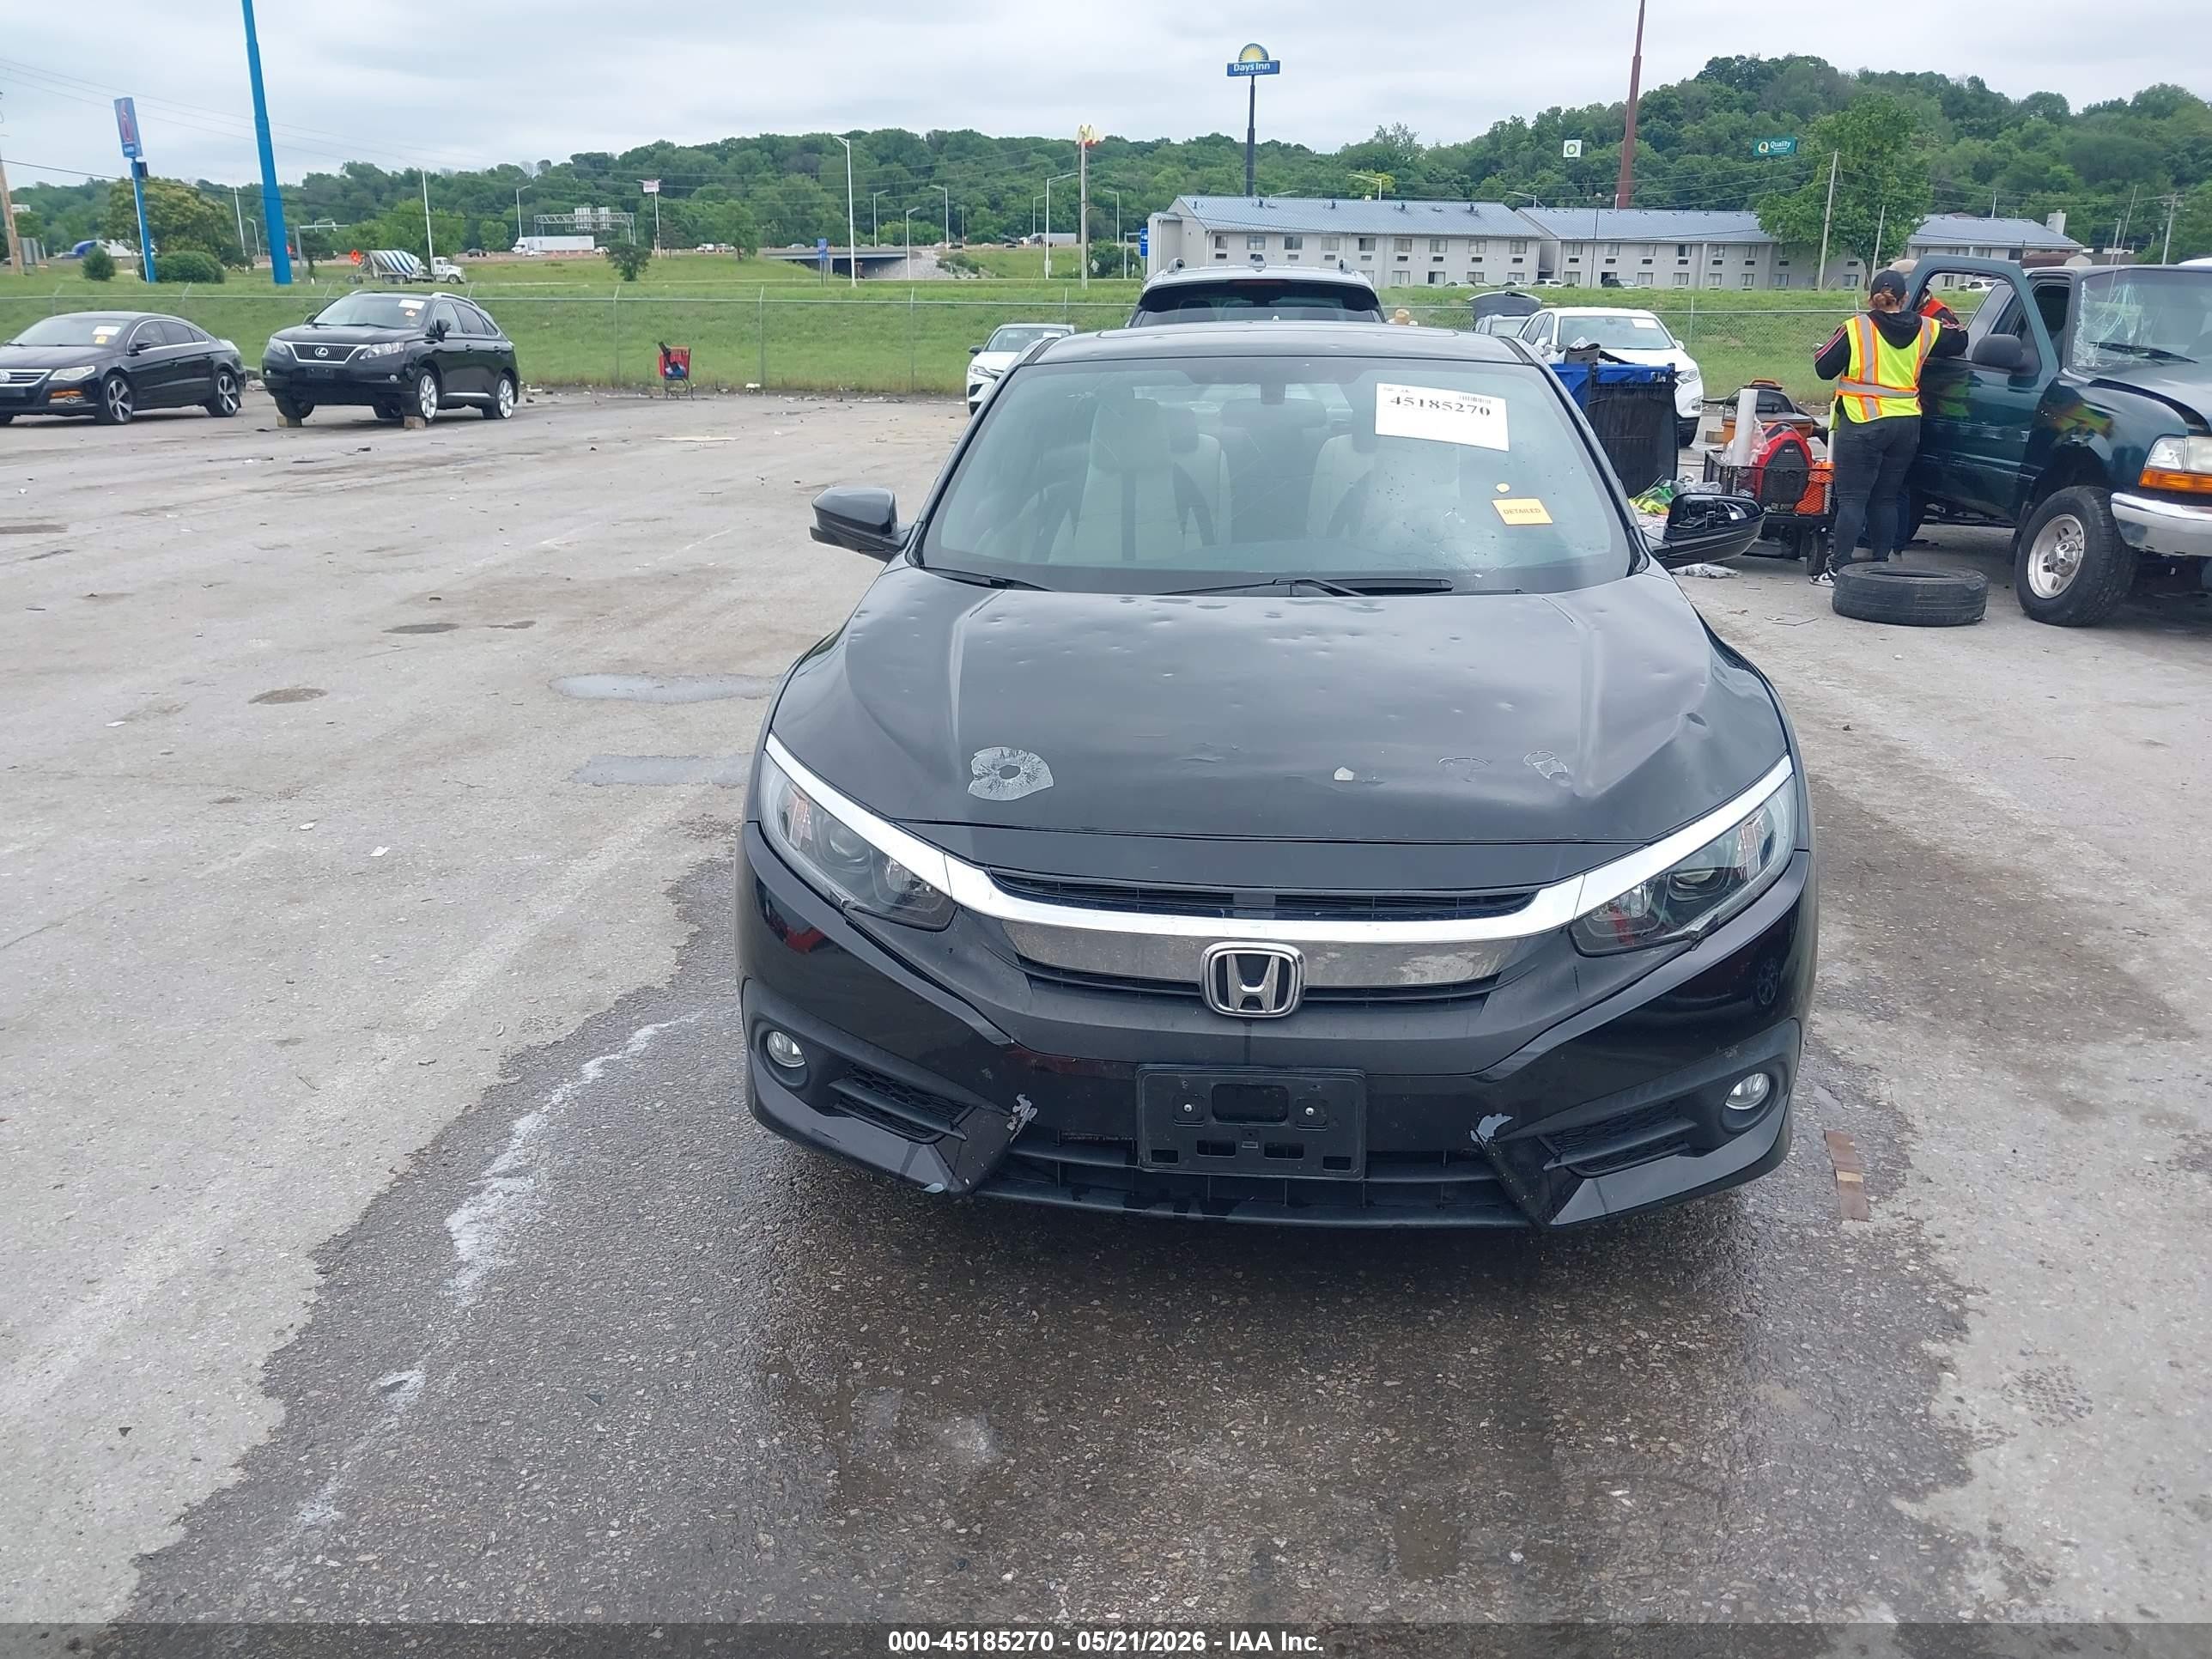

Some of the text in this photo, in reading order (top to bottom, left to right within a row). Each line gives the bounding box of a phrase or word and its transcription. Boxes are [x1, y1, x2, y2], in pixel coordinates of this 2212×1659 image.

[1233, 62, 1271, 72] Days Inn
[1770, 140, 1791, 149] Quality
[1389, 395, 1491, 416] 45185270
